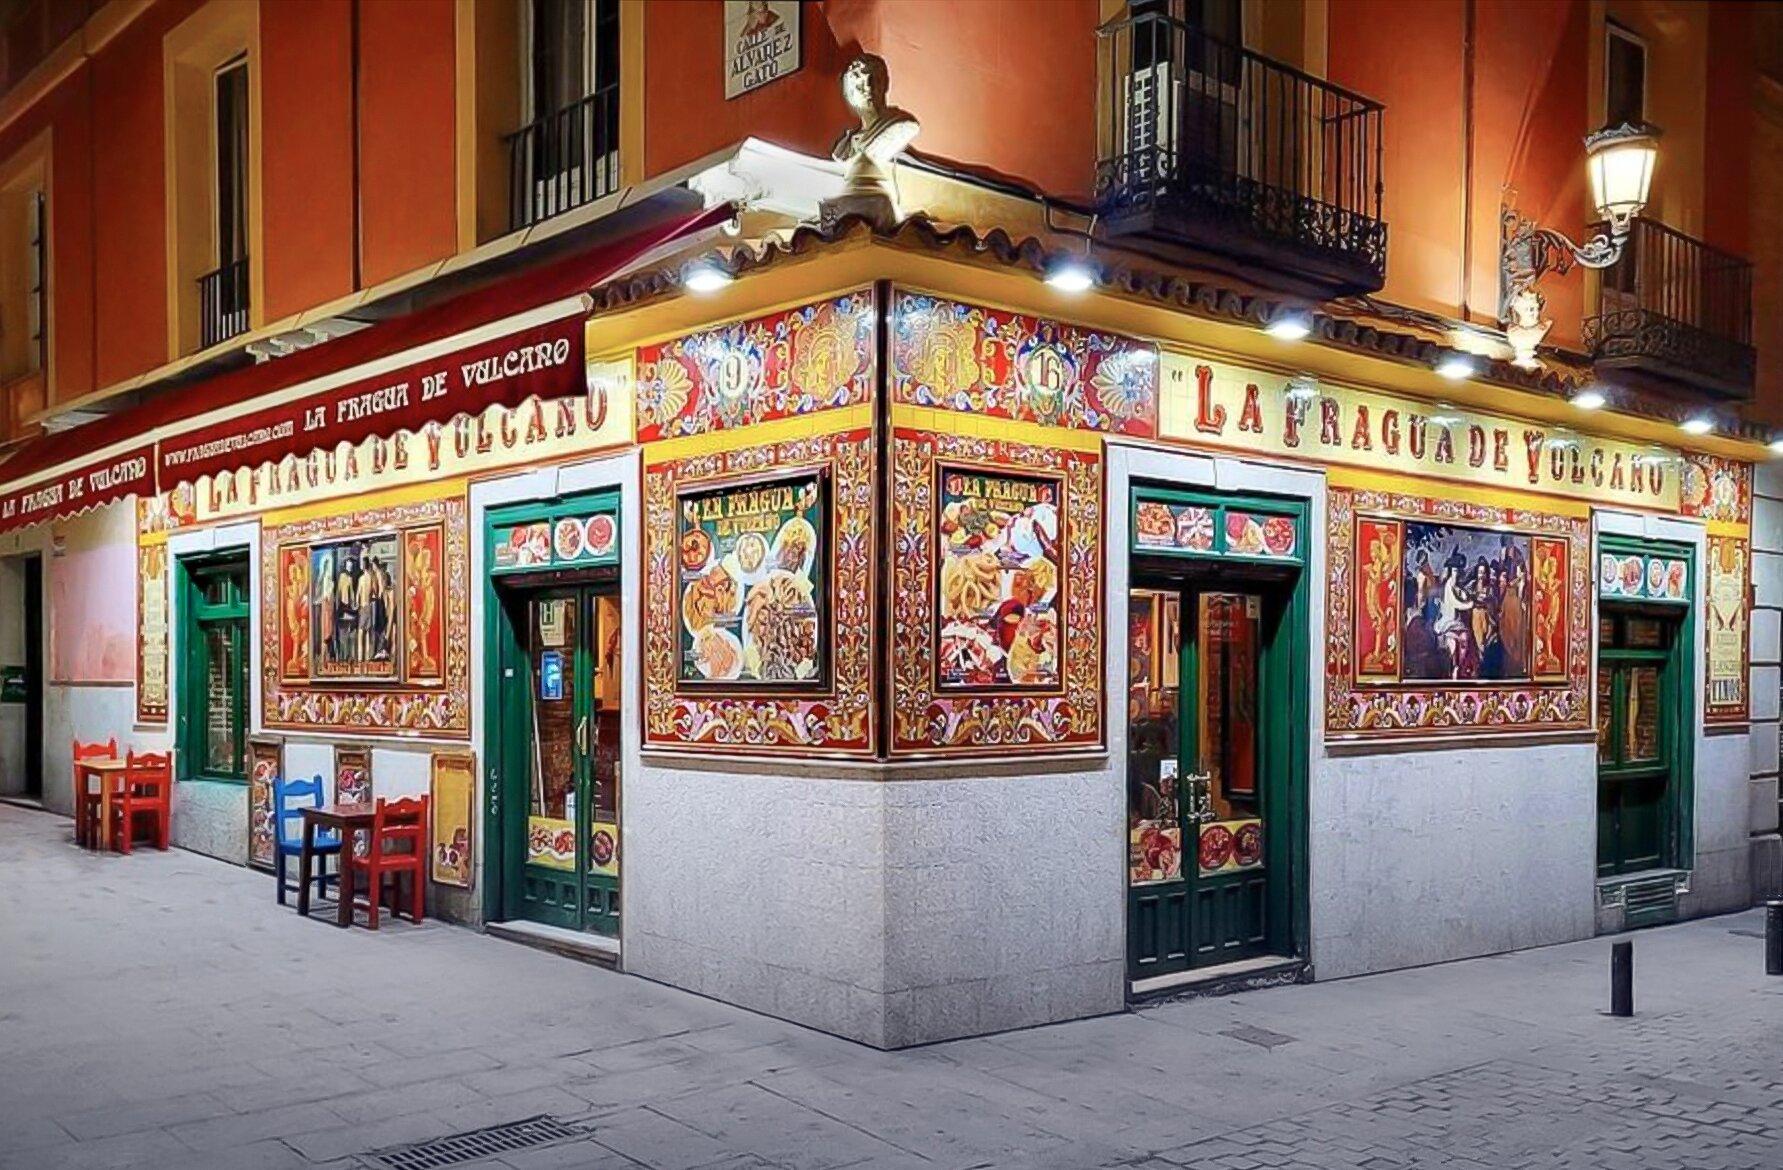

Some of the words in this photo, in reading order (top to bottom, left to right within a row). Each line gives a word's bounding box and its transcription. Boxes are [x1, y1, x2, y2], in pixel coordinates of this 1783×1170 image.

[731, 33, 793, 78] ALVAREZ
[736, 29, 769, 54] CALLE
[743, 60, 778, 88] GATO
[302, 405, 326, 431] LA
[336, 382, 410, 423] FRAGUA
[421, 371, 447, 402] DE
[460, 338, 570, 388] VULCANO
[726, 355, 741, 390] 9
[1037, 351, 1060, 391] 16
[1283, 380, 1456, 464] FRAGUA
[1467, 423, 1509, 472] DE
[2, 499, 16, 519] LA
[21, 483, 63, 514] FRAGUA
[68, 477, 84, 499] DE
[89, 456, 147, 493] VULCANO
[702, 496, 724, 521] LA
[727, 486, 795, 518] FRAGUA
